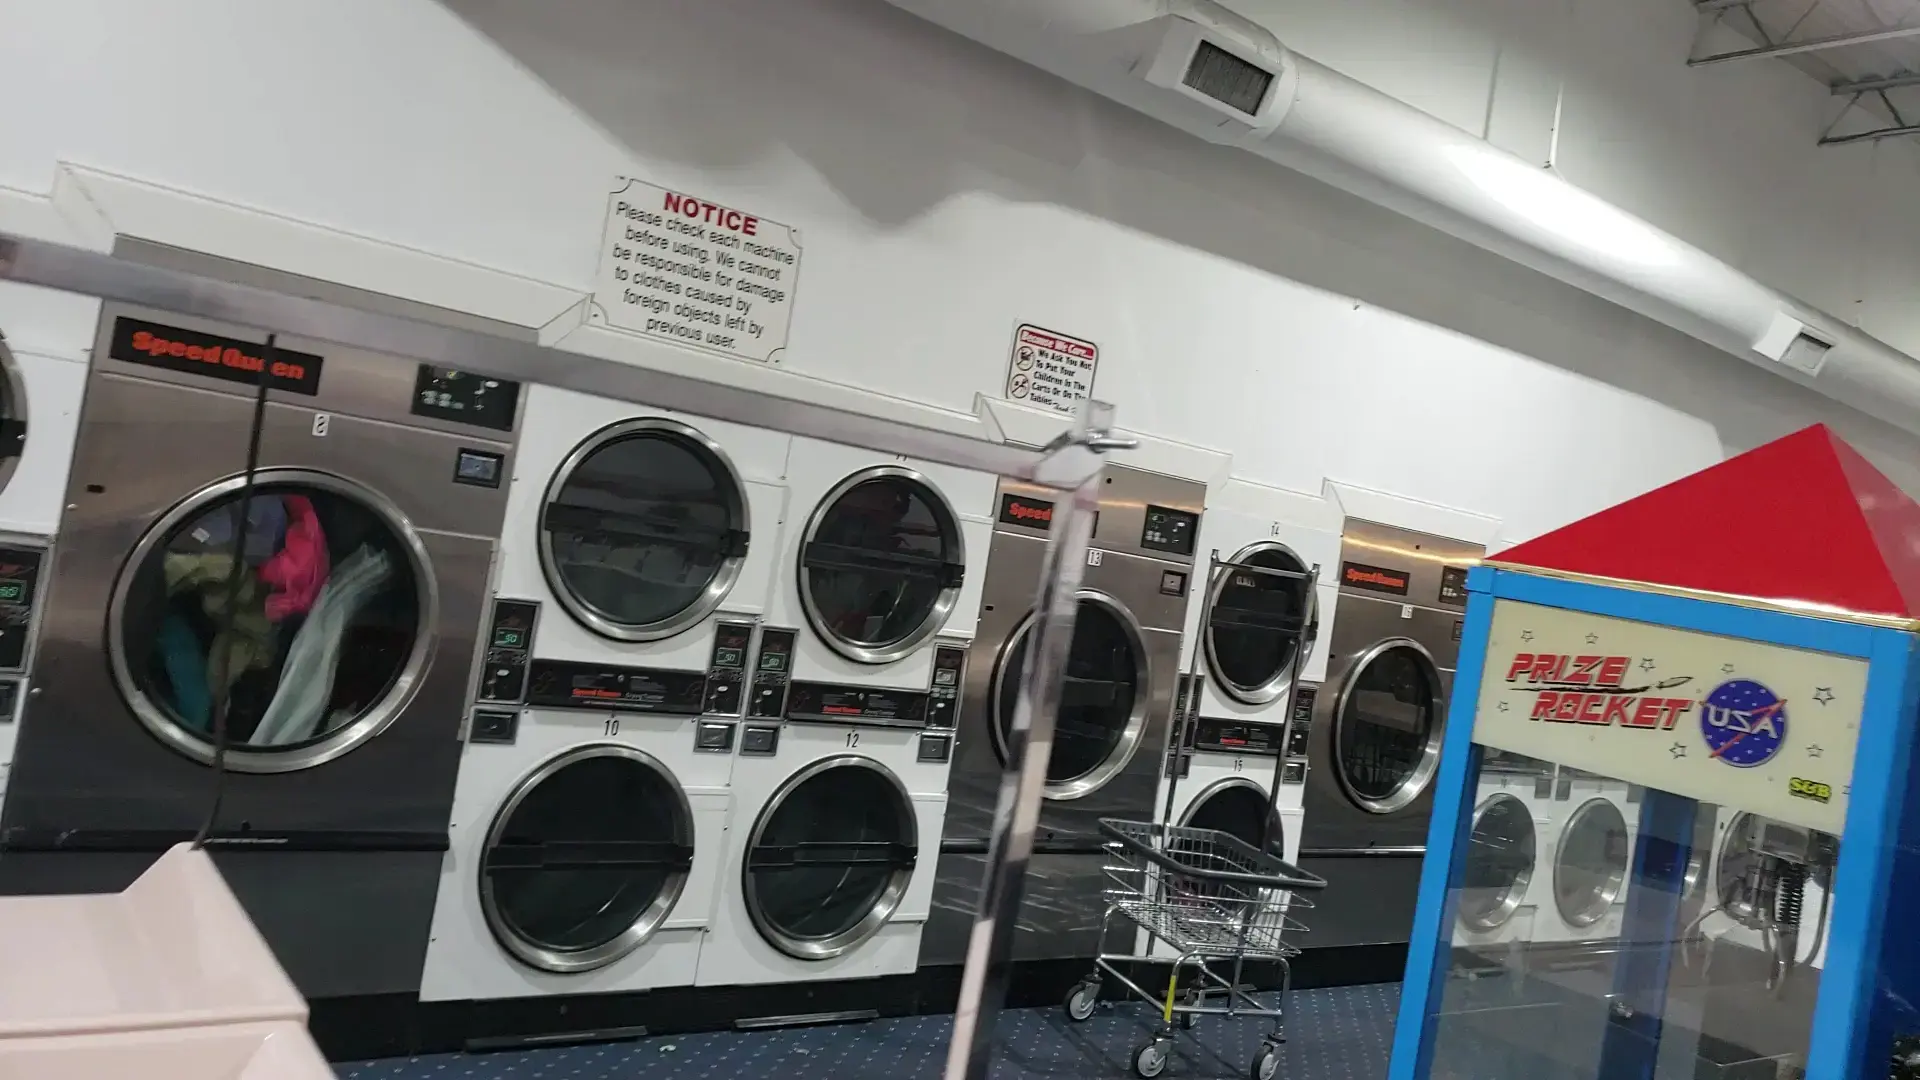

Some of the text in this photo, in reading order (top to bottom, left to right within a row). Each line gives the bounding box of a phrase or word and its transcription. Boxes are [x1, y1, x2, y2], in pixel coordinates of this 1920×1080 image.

[664, 192, 760, 236] NOTICE
[616, 201, 794, 265] Please check each machine
[625, 225, 781, 281] before using. We cannot
[612, 243, 786, 303] be responsible for damage
[615, 266, 752, 315] to clothes caused by
[623, 288, 765, 338] foreign objects left by
[132, 331, 223, 364] Speed
[646, 317, 736, 349] previous user.
[1036, 360, 1076, 377] To Put Your
[1038, 349, 1092, 370] We Ask You Not
[1032, 382, 1051, 394] Carts
[1052, 387, 1061, 396] Or
[1033, 371, 1063, 385] Children
[1074, 381, 1086, 391] The
[1271, 525, 1279, 536] 14
[1090, 551, 1101, 565] 13
[1505, 653, 1631, 688] PRIZE
[1530, 691, 1695, 731] ROCKET
[1706, 703, 1778, 739] USA
[604, 720, 620, 736] 10
[846, 733, 860, 748] 12
